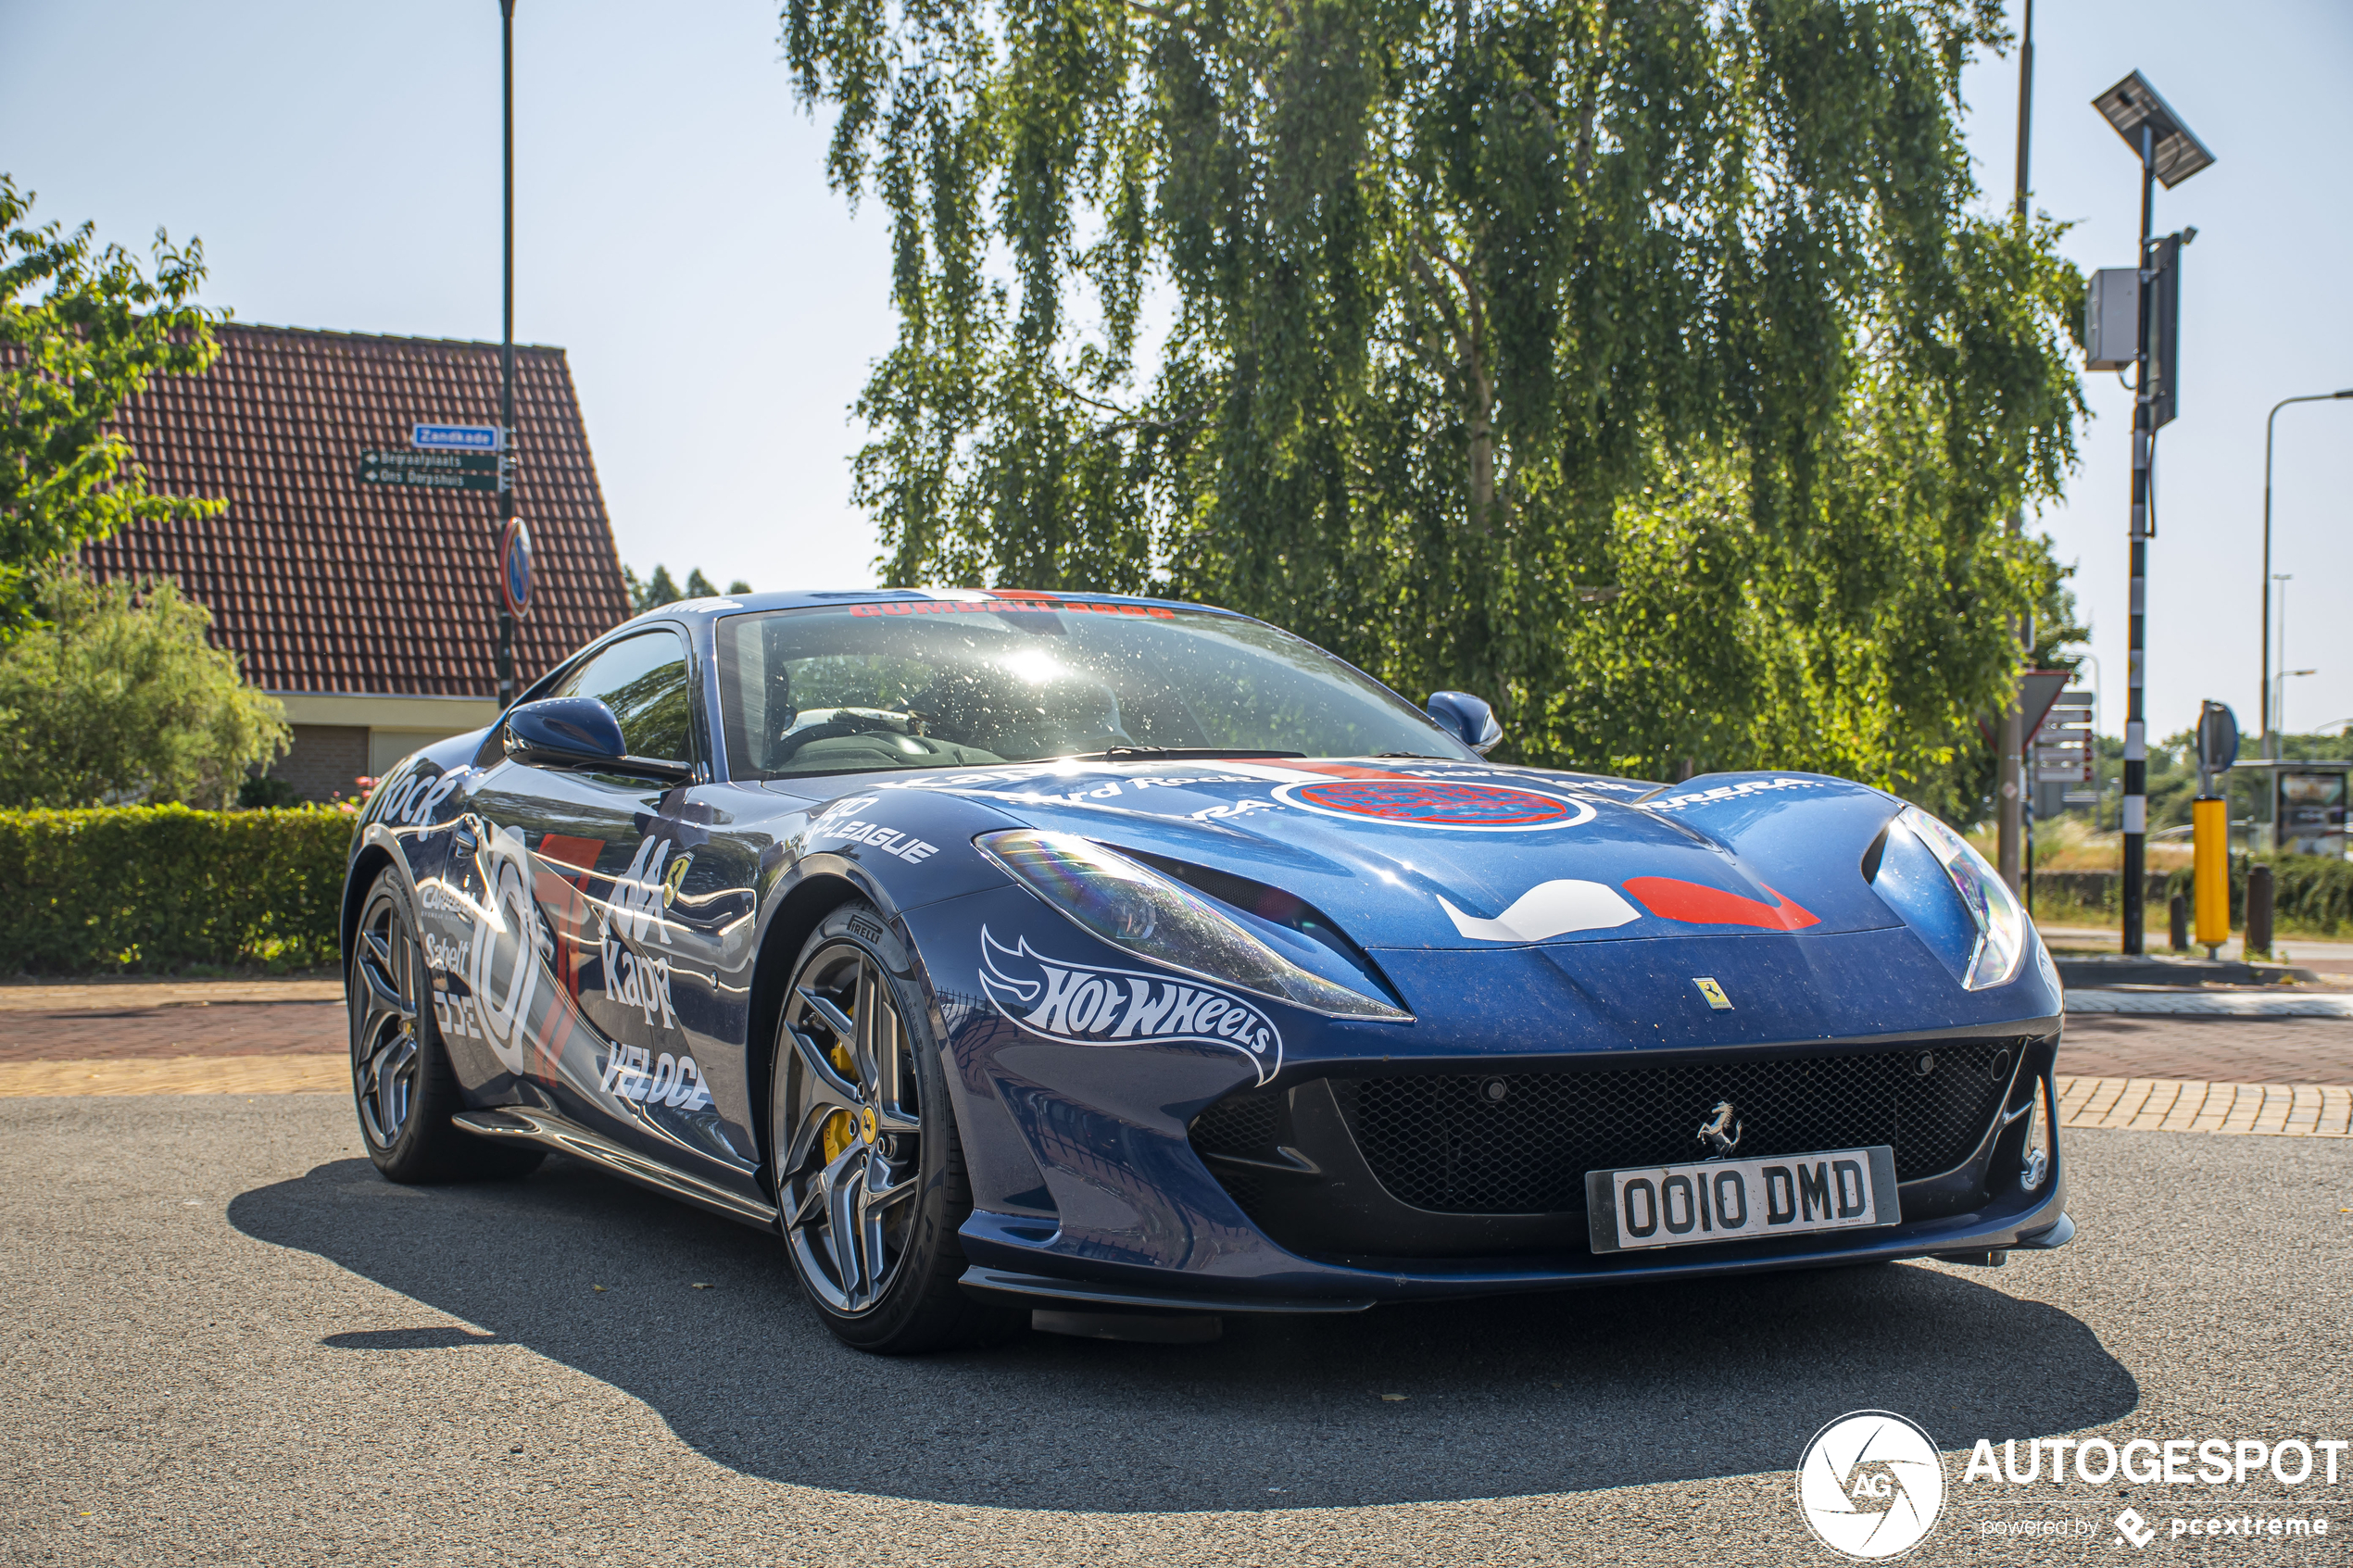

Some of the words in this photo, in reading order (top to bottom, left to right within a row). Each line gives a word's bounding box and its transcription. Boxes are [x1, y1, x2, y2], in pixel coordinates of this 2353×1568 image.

[421, 429, 490, 445] Zandkade
[380, 452, 462, 468] Begraafplaats
[380, 468, 403, 482] Ons
[408, 470, 464, 487] Dorpshuis
[849, 601, 1059, 618] GUMBALL
[1065, 602, 1176, 620] 3000
[847, 914, 883, 945] PIRELLI
[426, 933, 470, 974] Sabelt
[1761, 1159, 1866, 1226] DMD
